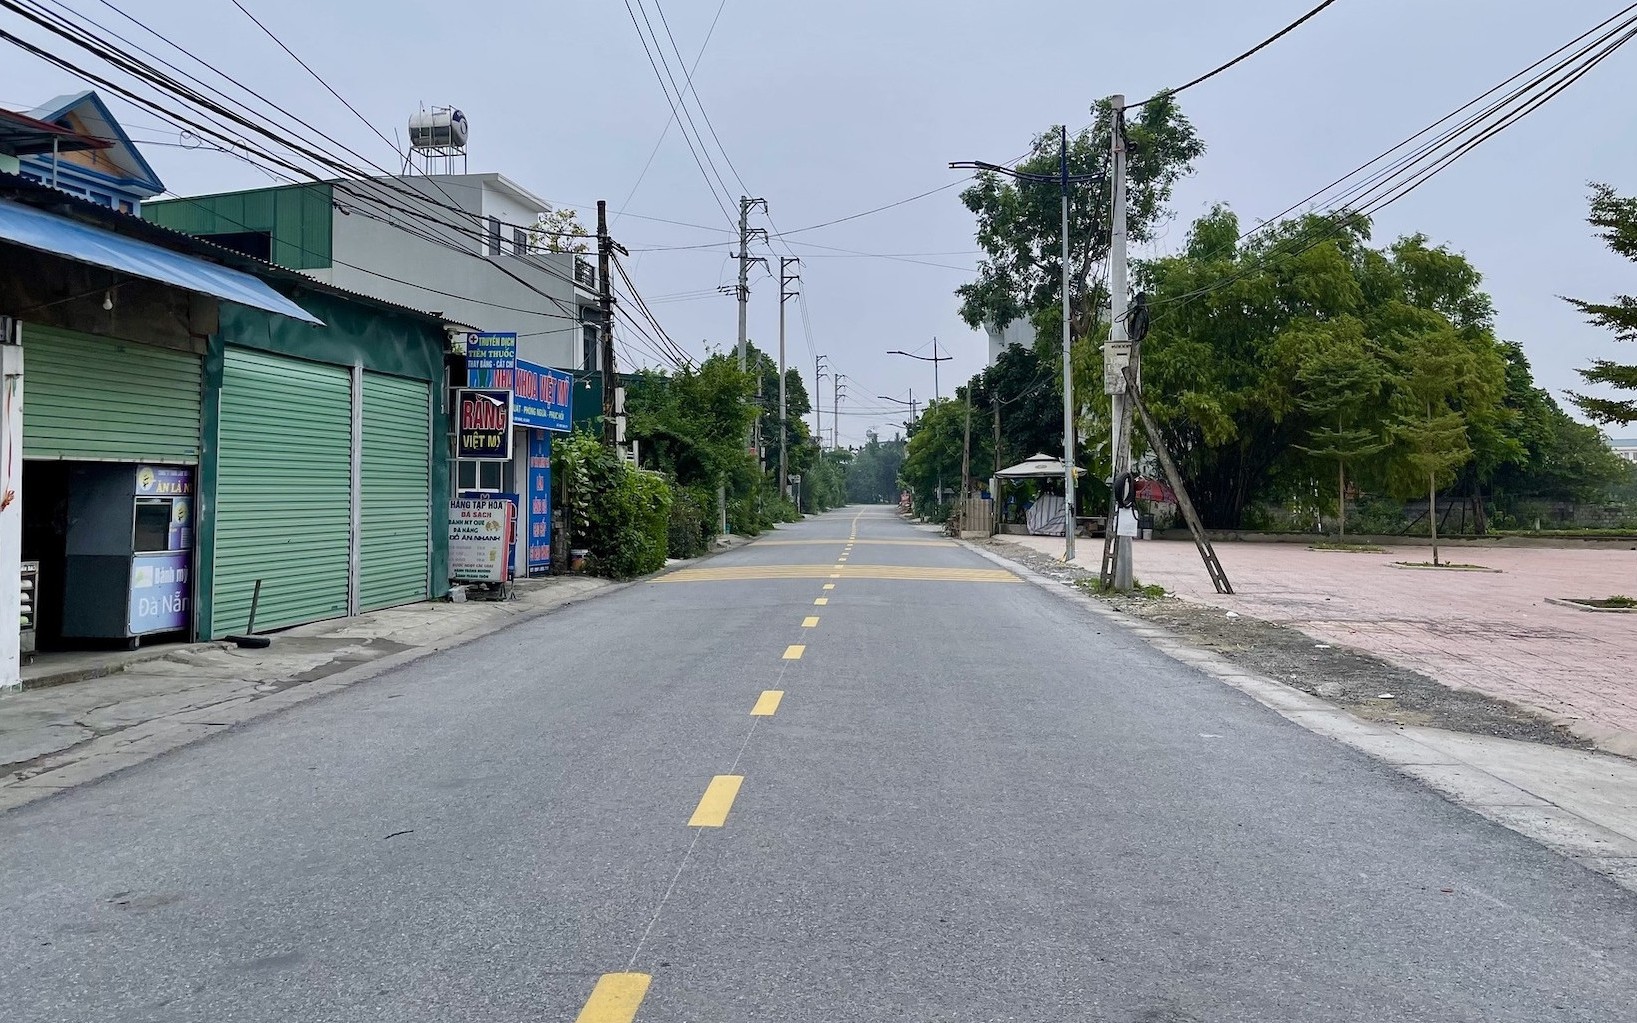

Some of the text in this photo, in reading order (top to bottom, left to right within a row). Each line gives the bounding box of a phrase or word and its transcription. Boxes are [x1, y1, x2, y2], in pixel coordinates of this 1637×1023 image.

[488, 347, 515, 358] THUỐC
[468, 360, 479, 368] THAY
[515, 369, 538, 401] KHOA
[540, 371, 557, 409] VIỆT
[557, 375, 570, 407] MỸ
[463, 395, 507, 433] RĂNG
[463, 431, 502, 449] VIỆT MỸ
[473, 500, 487, 511] TẠP
[154, 566, 175, 585] Bánh
[138, 591, 190, 617] Đà Nẵn
